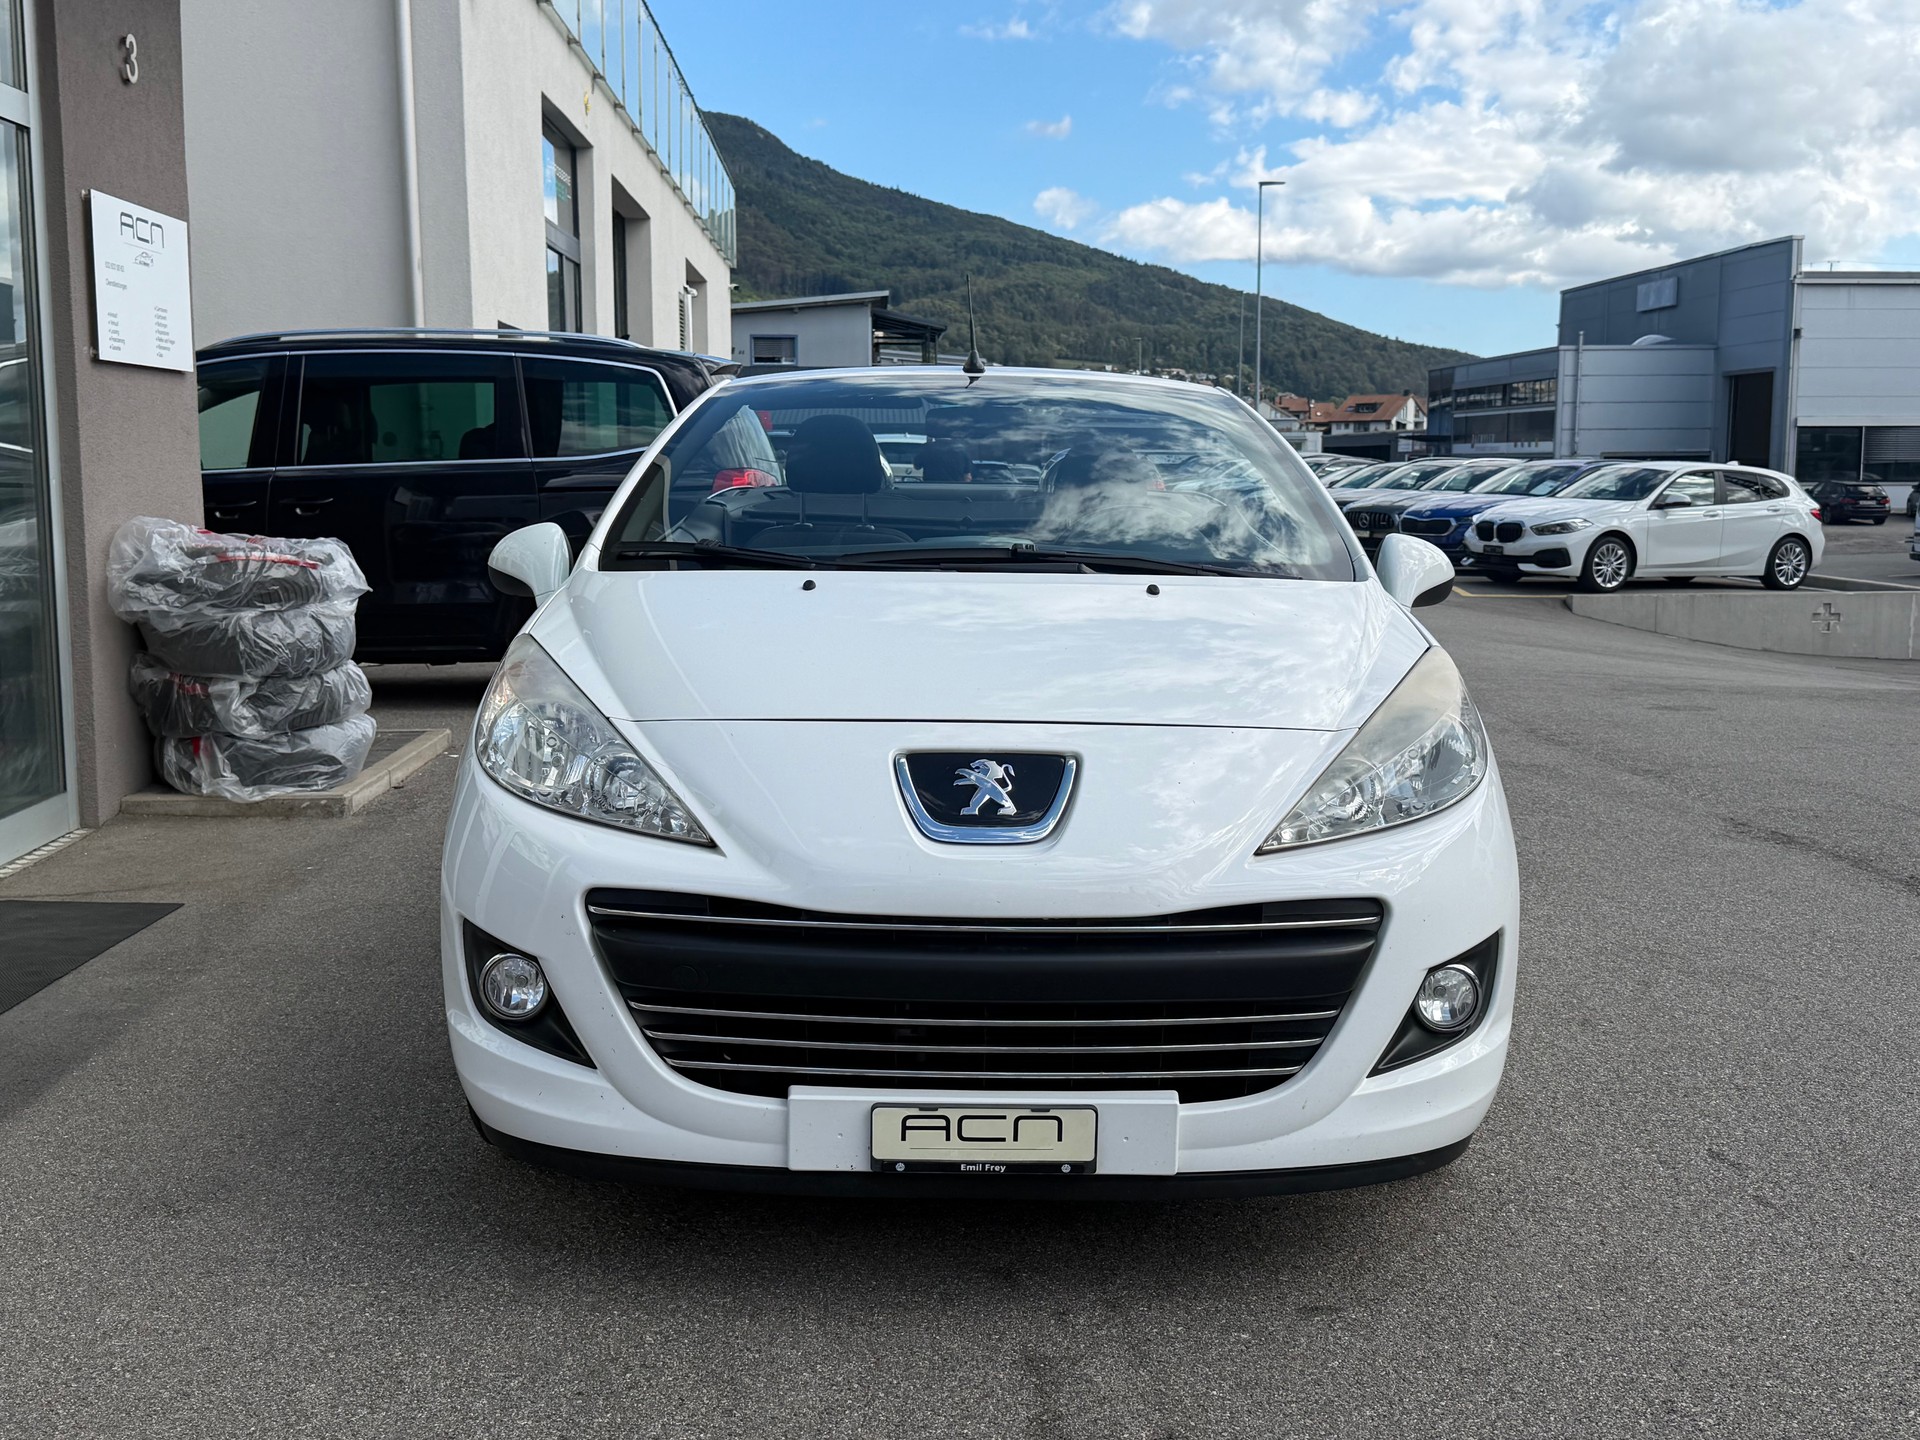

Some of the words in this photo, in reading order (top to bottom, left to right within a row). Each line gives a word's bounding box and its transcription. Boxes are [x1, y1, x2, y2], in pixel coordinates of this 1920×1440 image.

[126, 33, 138, 84] 3
[960, 1163, 982, 1172] Emil
[985, 1163, 1007, 1173] Frey
